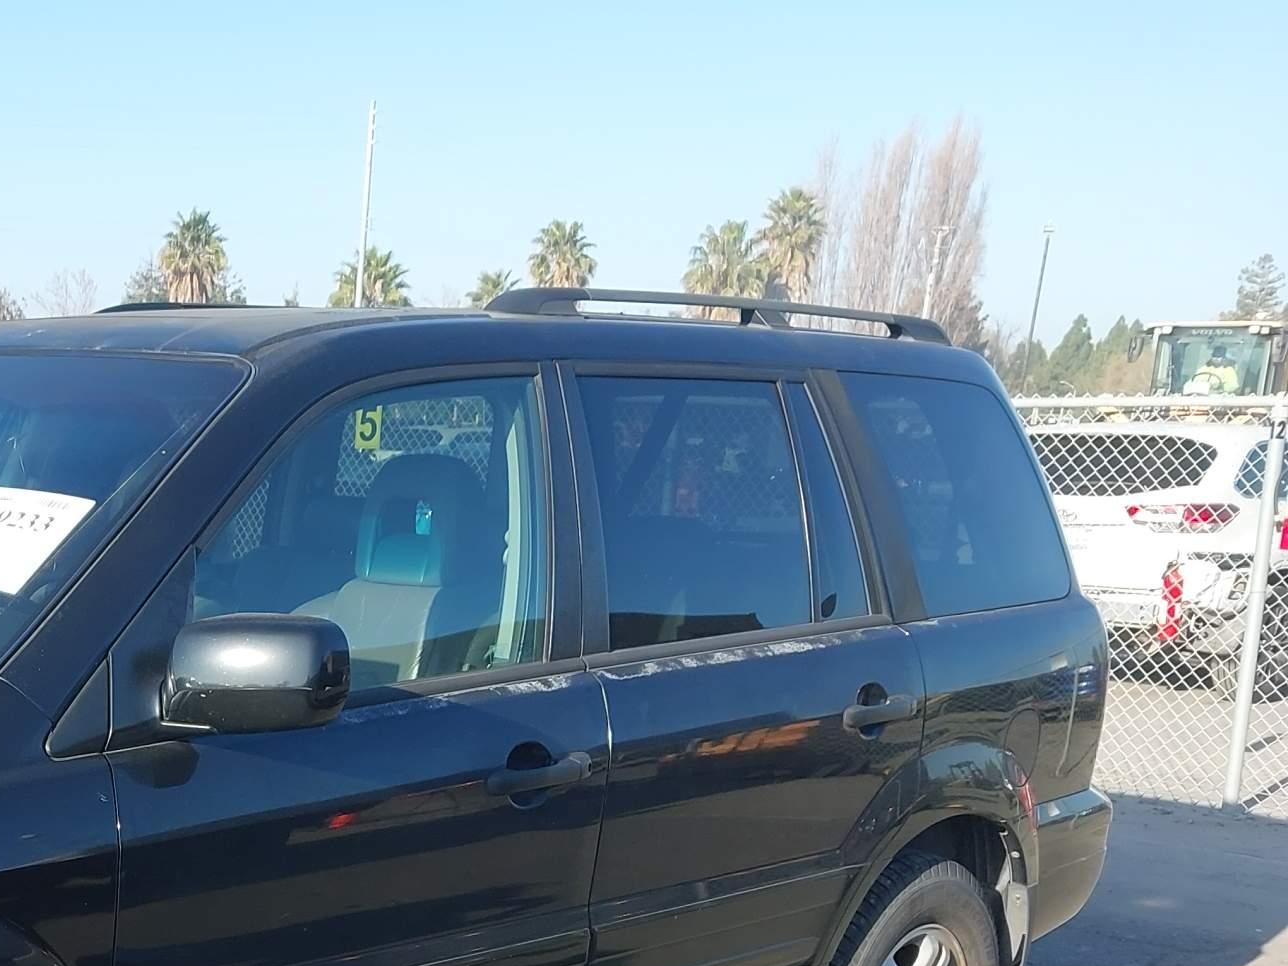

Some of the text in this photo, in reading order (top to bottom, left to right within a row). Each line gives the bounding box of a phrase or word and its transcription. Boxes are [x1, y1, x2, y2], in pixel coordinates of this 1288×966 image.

[1192, 328, 1233, 336] VOLVO
[359, 408, 377, 442] 5
[1270, 420, 1286, 440] 12
